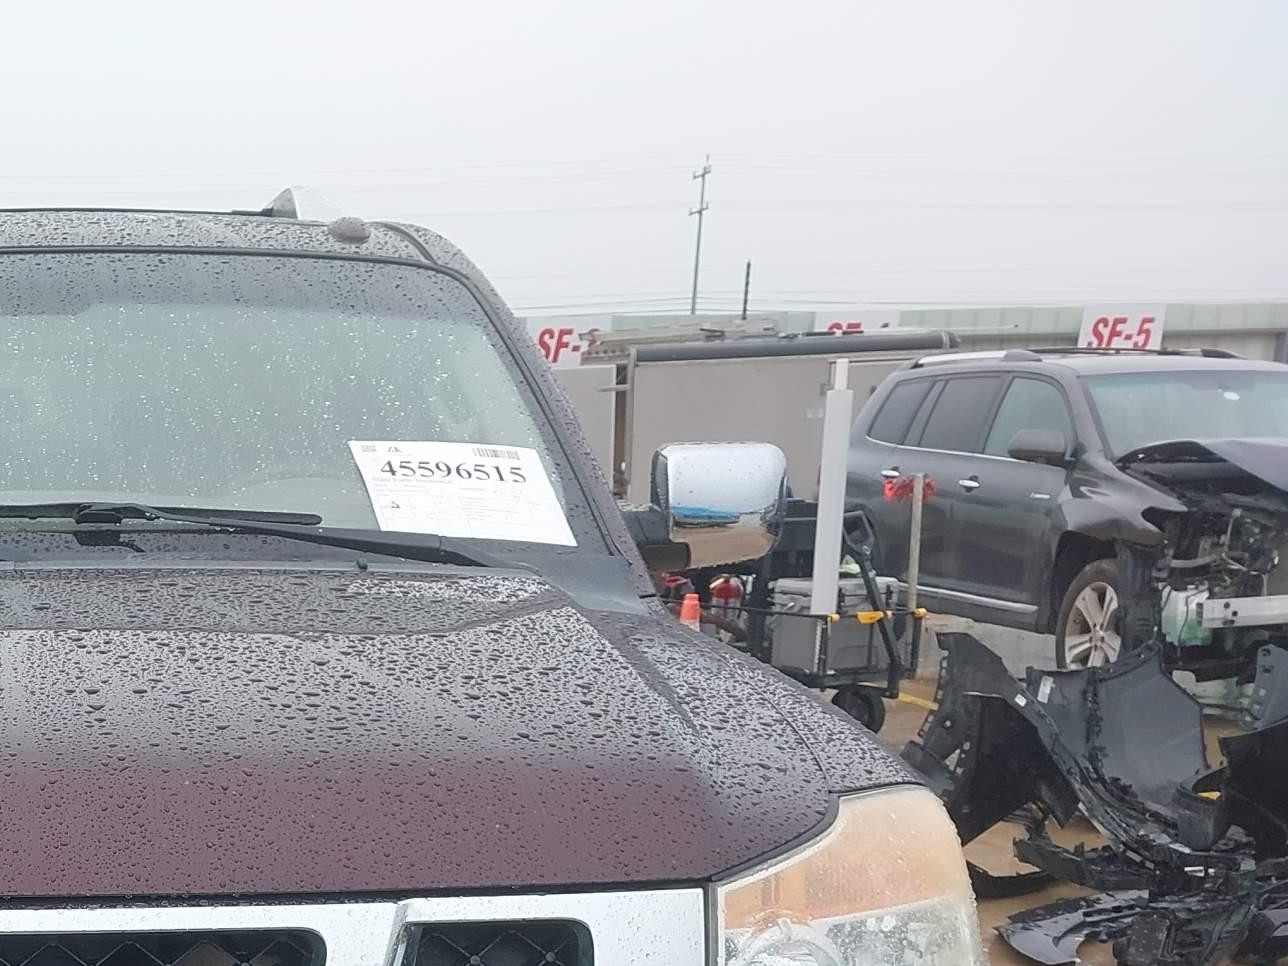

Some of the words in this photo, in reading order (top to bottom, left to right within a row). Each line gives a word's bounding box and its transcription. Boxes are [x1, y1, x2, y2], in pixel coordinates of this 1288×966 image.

[538, 328, 582, 363] SF-
[1092, 316, 1156, 349] SF-5
[380, 460, 527, 483] 45596515
